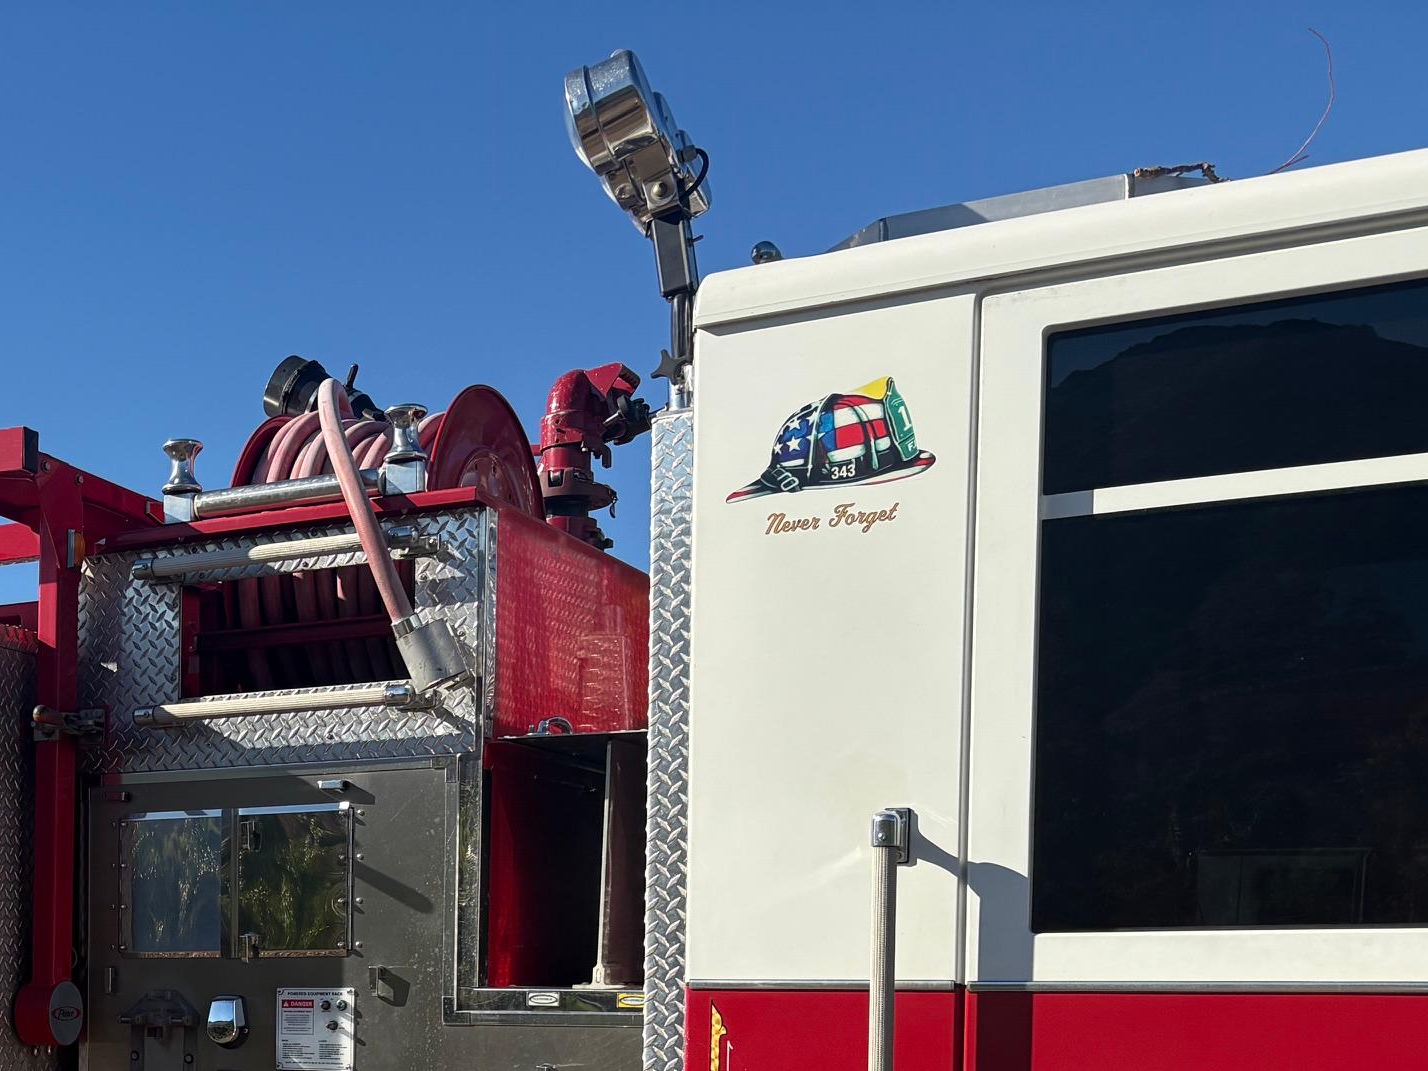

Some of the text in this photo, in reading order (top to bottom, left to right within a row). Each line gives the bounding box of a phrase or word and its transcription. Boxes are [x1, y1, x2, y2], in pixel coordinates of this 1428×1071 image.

[898, 406, 912, 431] 1
[831, 464, 856, 479] 343
[765, 502, 900, 535] Never Forget
